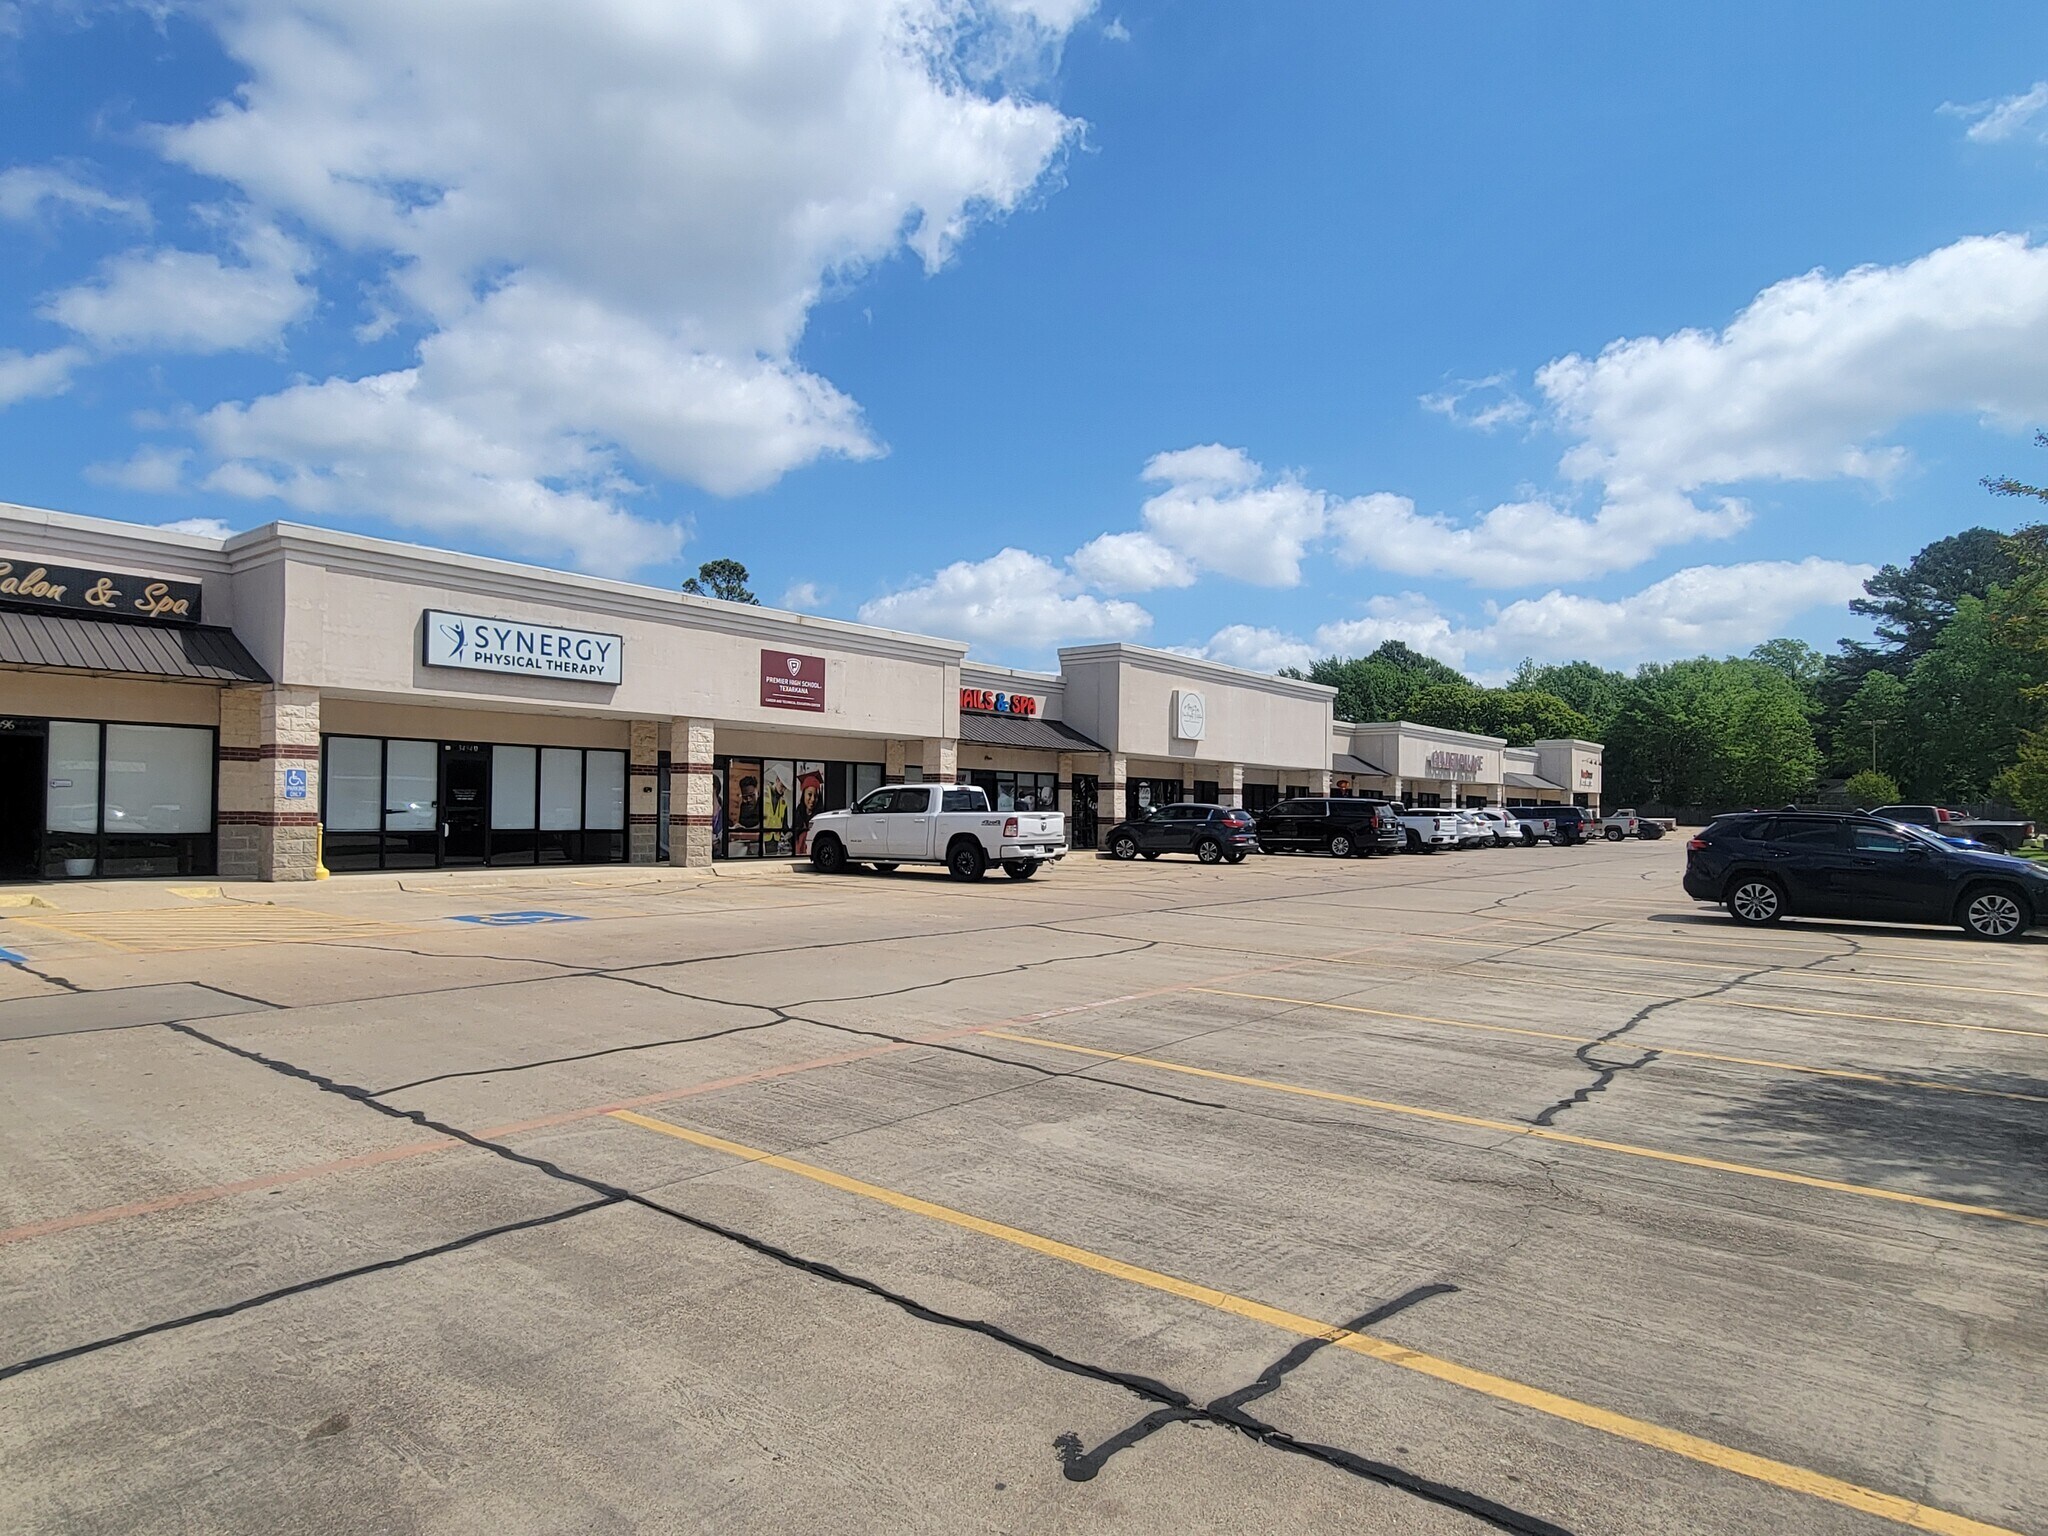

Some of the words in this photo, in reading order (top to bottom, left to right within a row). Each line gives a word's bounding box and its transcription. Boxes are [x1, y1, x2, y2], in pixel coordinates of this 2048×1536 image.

[85, 577, 122, 608] &
[134, 583, 190, 617] Spa
[475, 625, 612, 663] SYNERGY
[474, 651, 542, 670] PHYSICAL
[546, 659, 605, 676] THERAPY
[766, 676, 789, 685] PREMIER
[994, 692, 1009, 713] &
[1010, 694, 1037, 715] SPA
